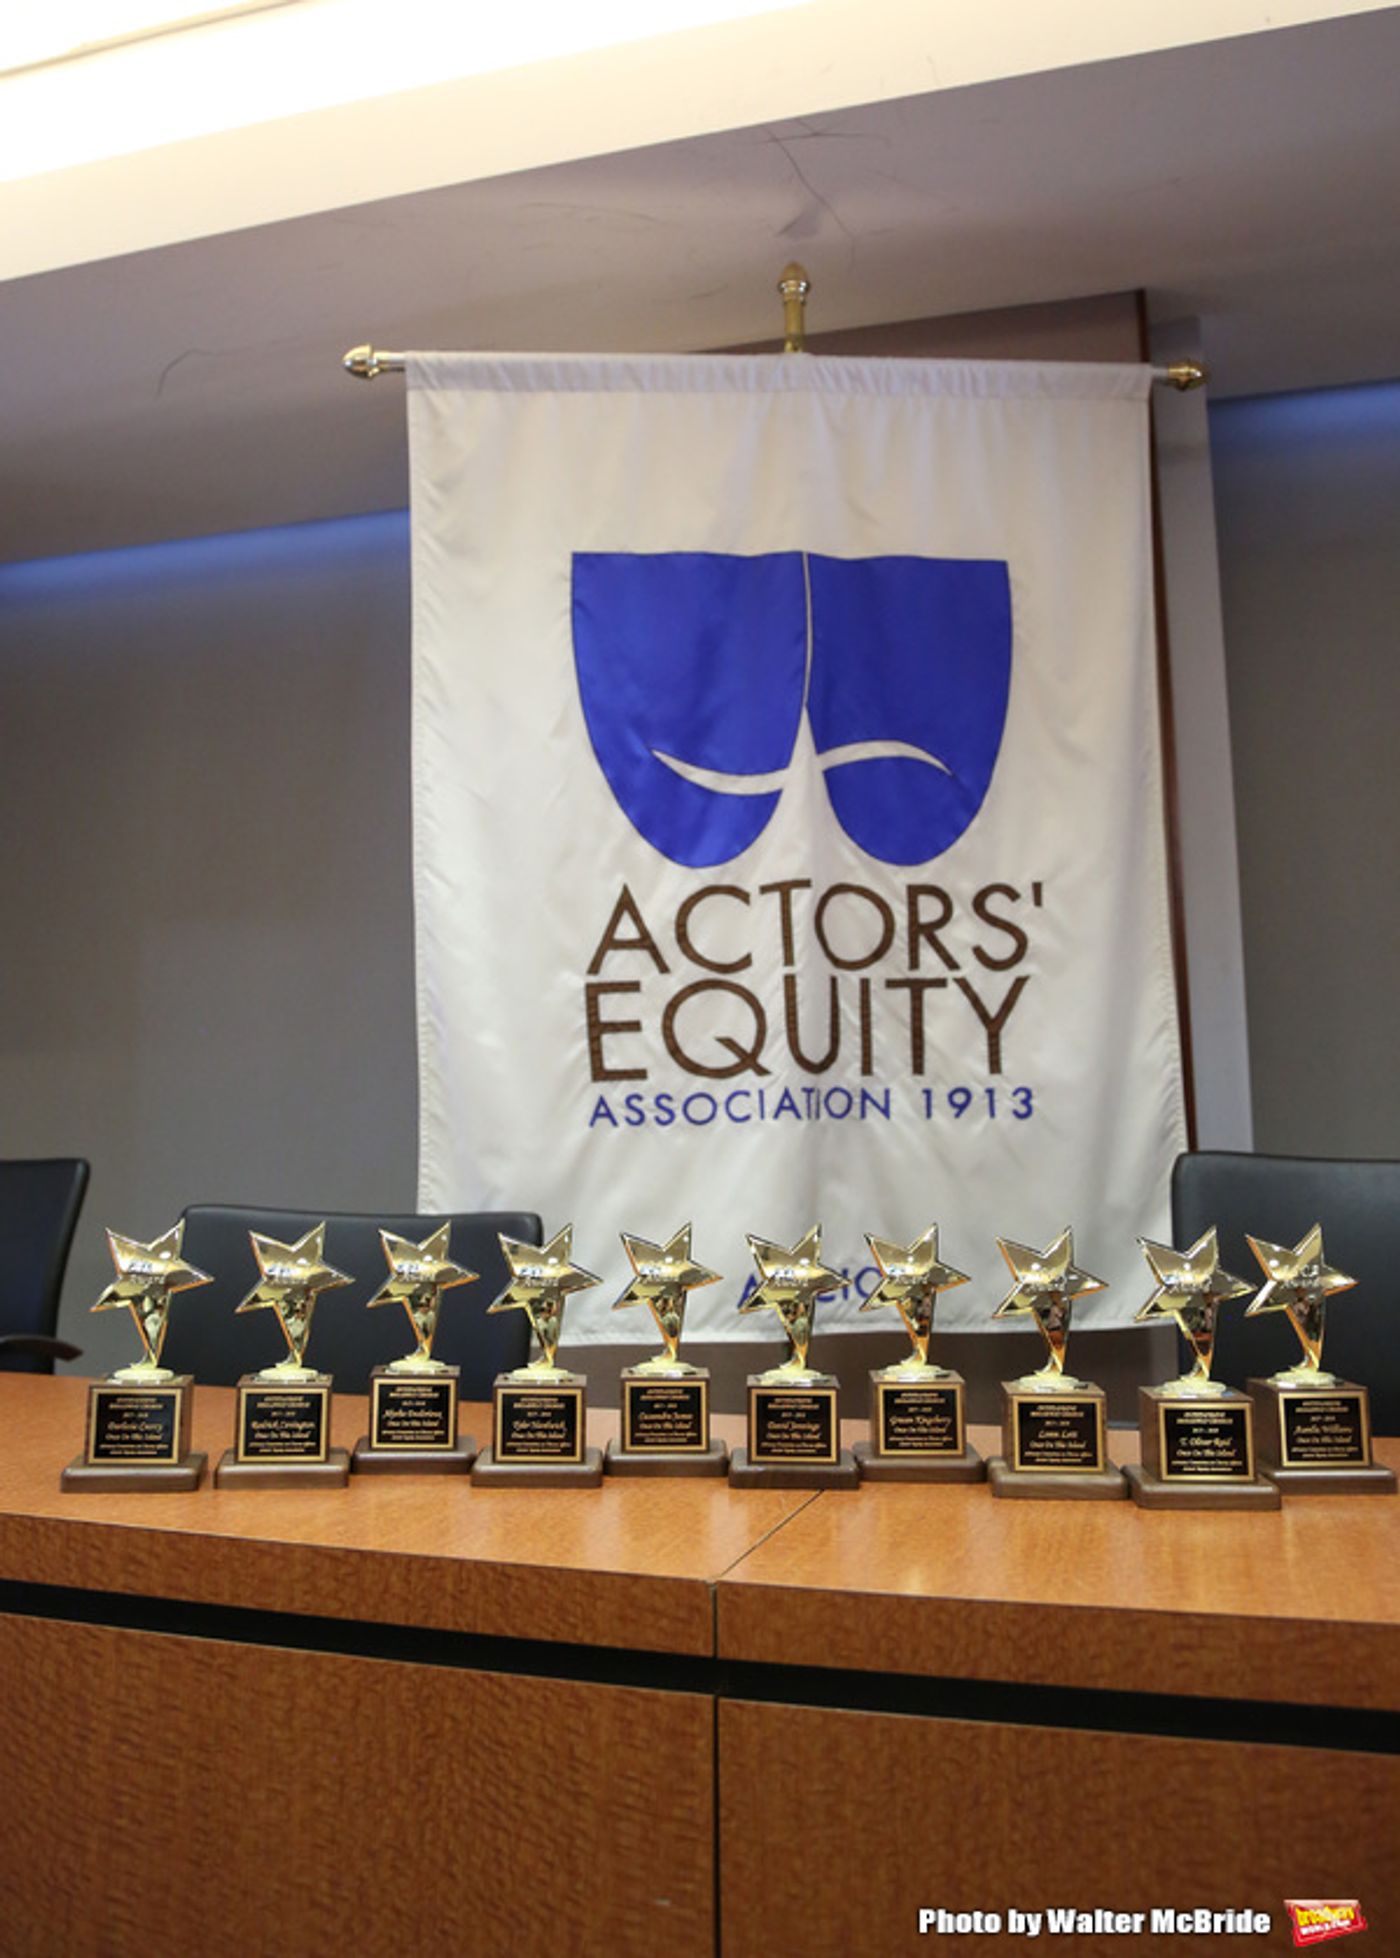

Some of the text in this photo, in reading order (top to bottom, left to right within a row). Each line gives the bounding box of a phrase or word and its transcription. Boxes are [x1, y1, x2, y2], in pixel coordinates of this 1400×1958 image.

[586, 878, 1043, 974] ACTORS'
[585, 973, 1031, 1082] EQUITY
[589, 1086, 1034, 1128] ASSOCIATION 1913
